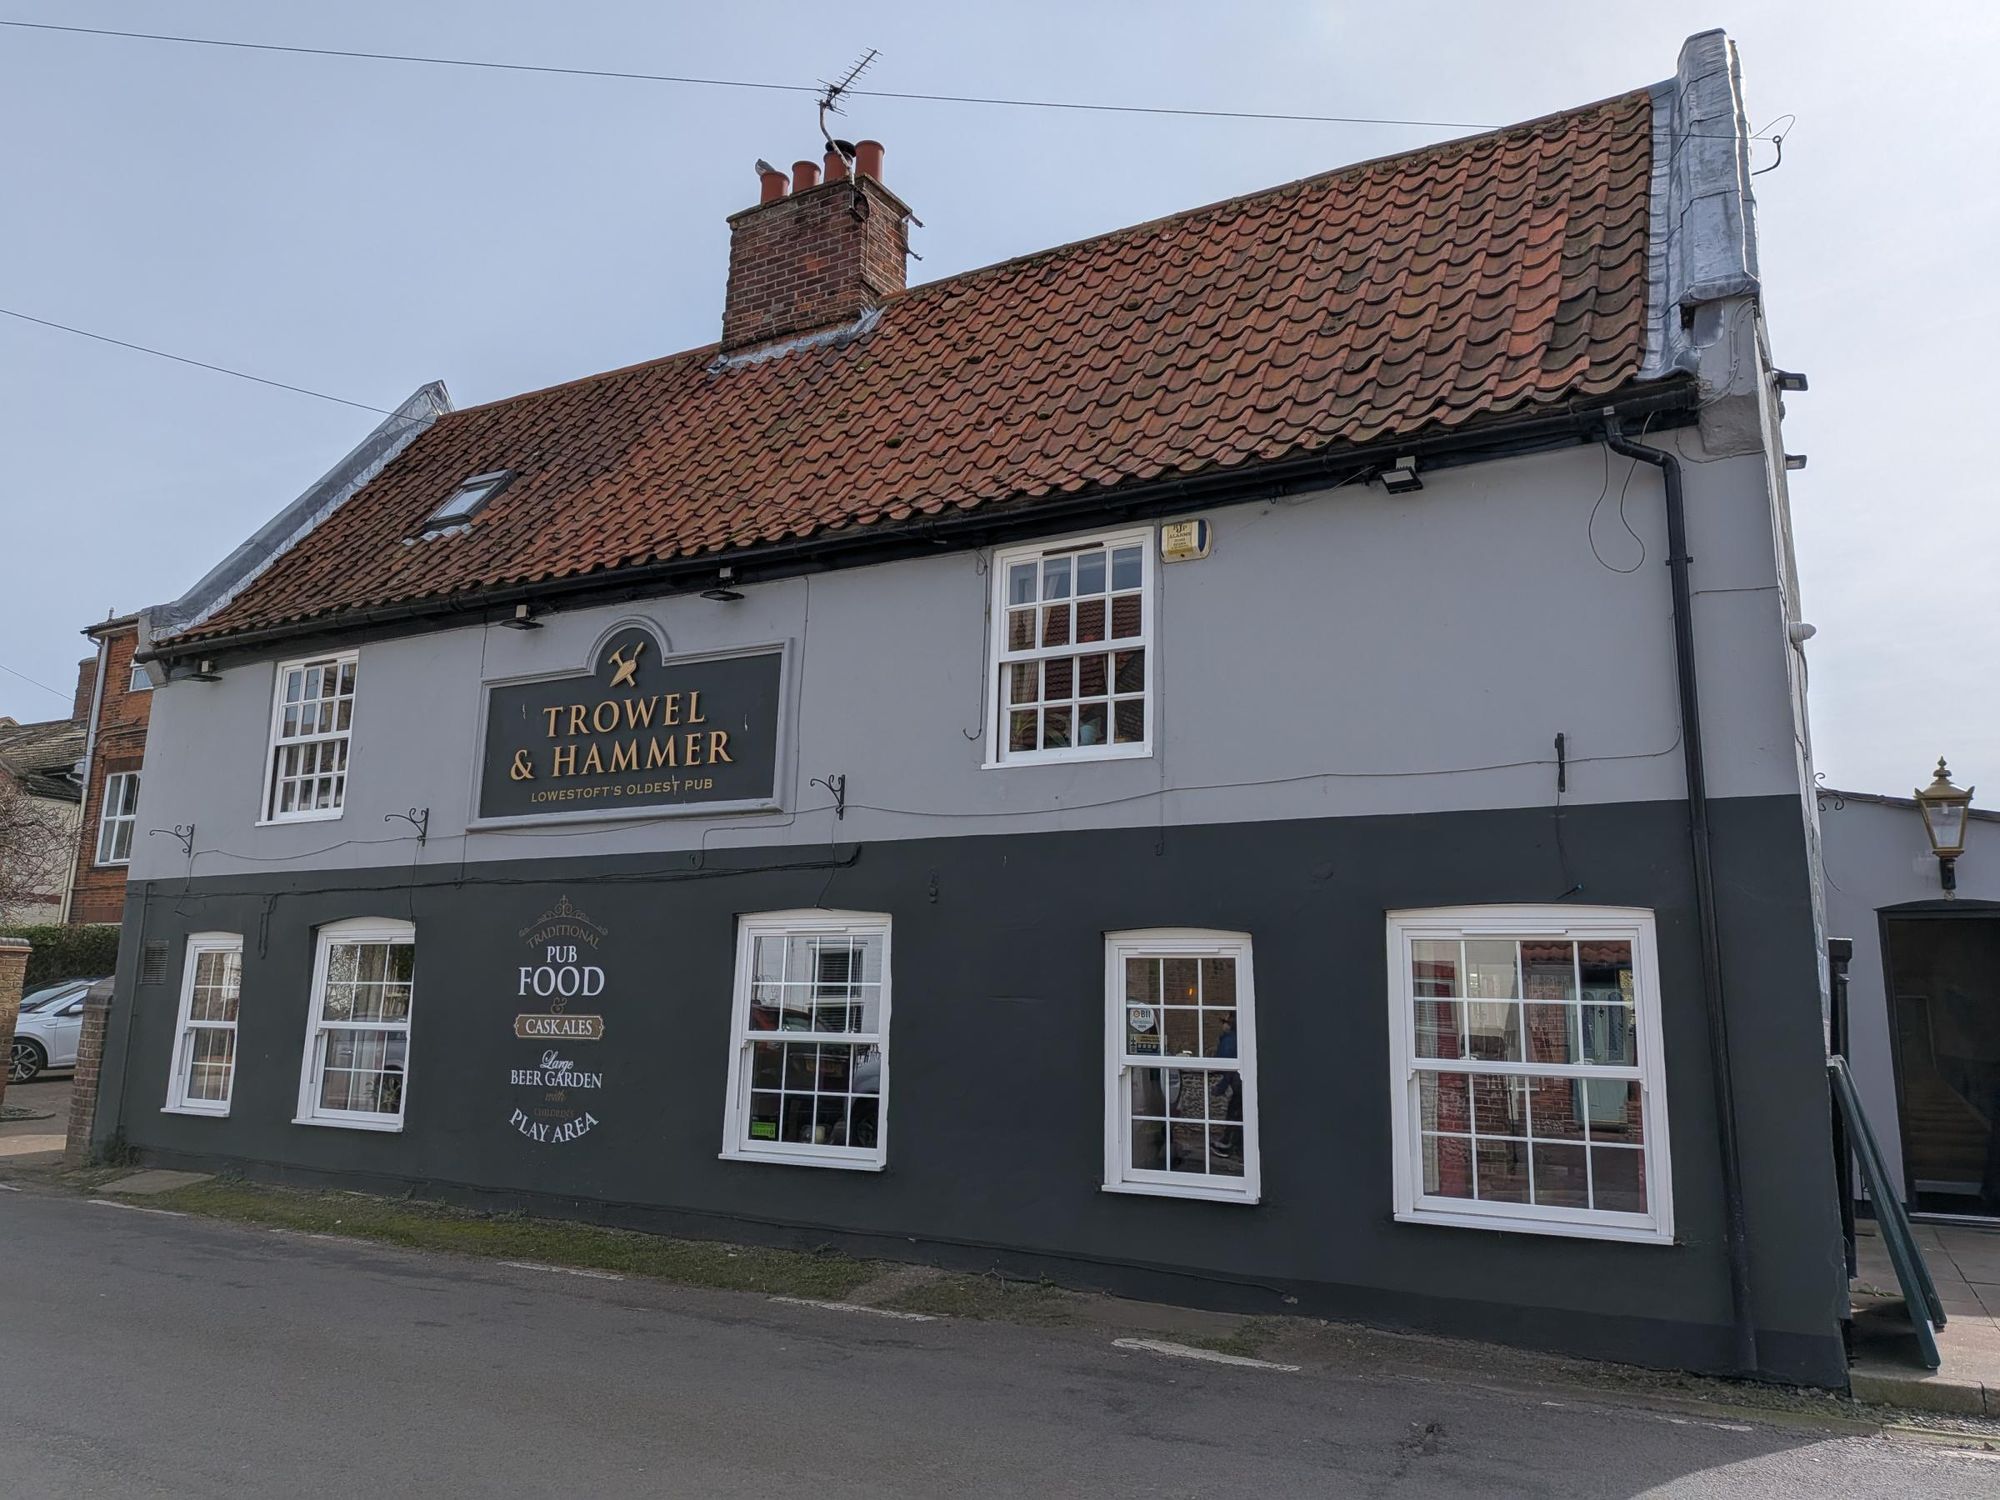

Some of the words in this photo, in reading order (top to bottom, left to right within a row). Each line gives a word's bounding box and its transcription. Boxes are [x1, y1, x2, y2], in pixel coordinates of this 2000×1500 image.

[543, 690, 705, 737] TROWEL
[510, 749, 535, 781] &
[551, 729, 733, 777] HAMMER
[530, 785, 622, 803] LOWESTOFT'S
[626, 780, 680, 796] OLDEST
[685, 778, 713, 791] PUB
[527, 924, 600, 950] TRADITIONAL
[546, 945, 578, 963] PUB
[518, 966, 605, 997] FOOD
[550, 997, 567, 1014] &
[525, 1018, 561, 1035] CASK
[562, 1019, 593, 1036] ALES
[540, 1049, 574, 1076] Large
[510, 1069, 543, 1086] BEER
[544, 1070, 603, 1088] GARDEN
[508, 1108, 550, 1142] PLAY
[551, 1111, 600, 1143] AREA
